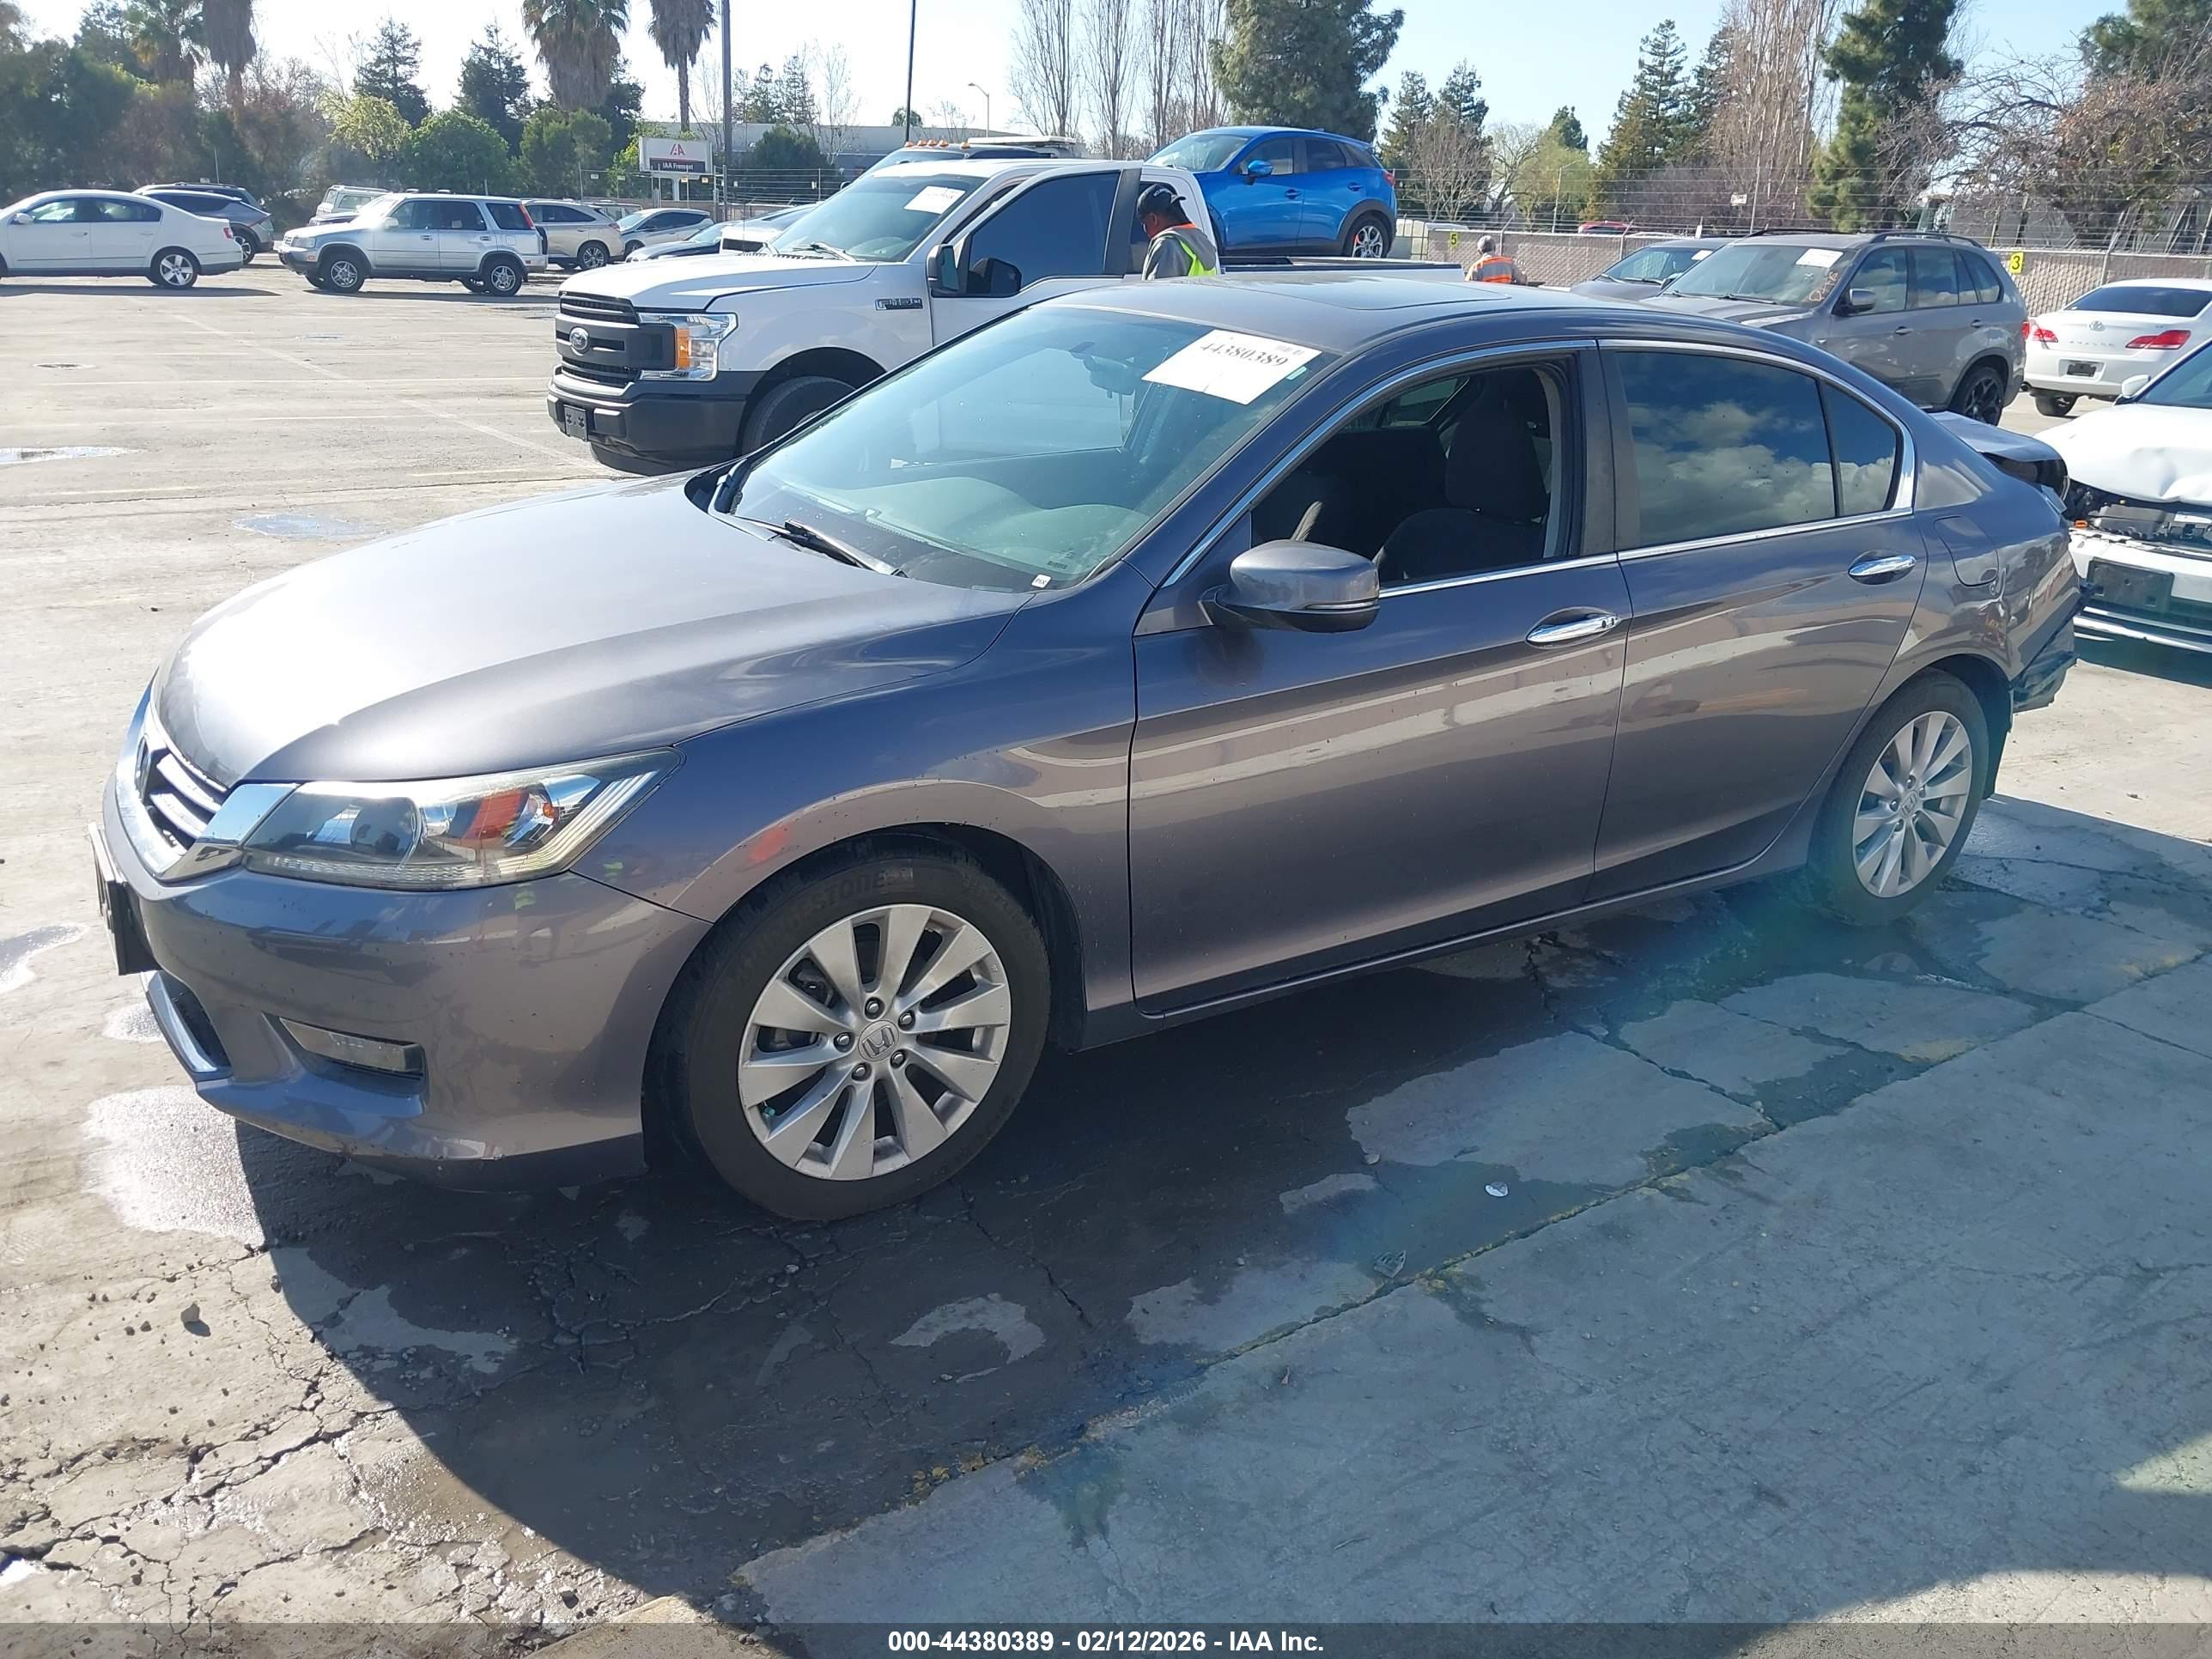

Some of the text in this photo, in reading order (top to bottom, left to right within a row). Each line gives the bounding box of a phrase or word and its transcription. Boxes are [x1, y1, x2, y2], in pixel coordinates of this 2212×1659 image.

[1451, 234, 1457, 246] 5
[2012, 255, 2021, 270] 3
[1200, 343, 1289, 367] 44380389
